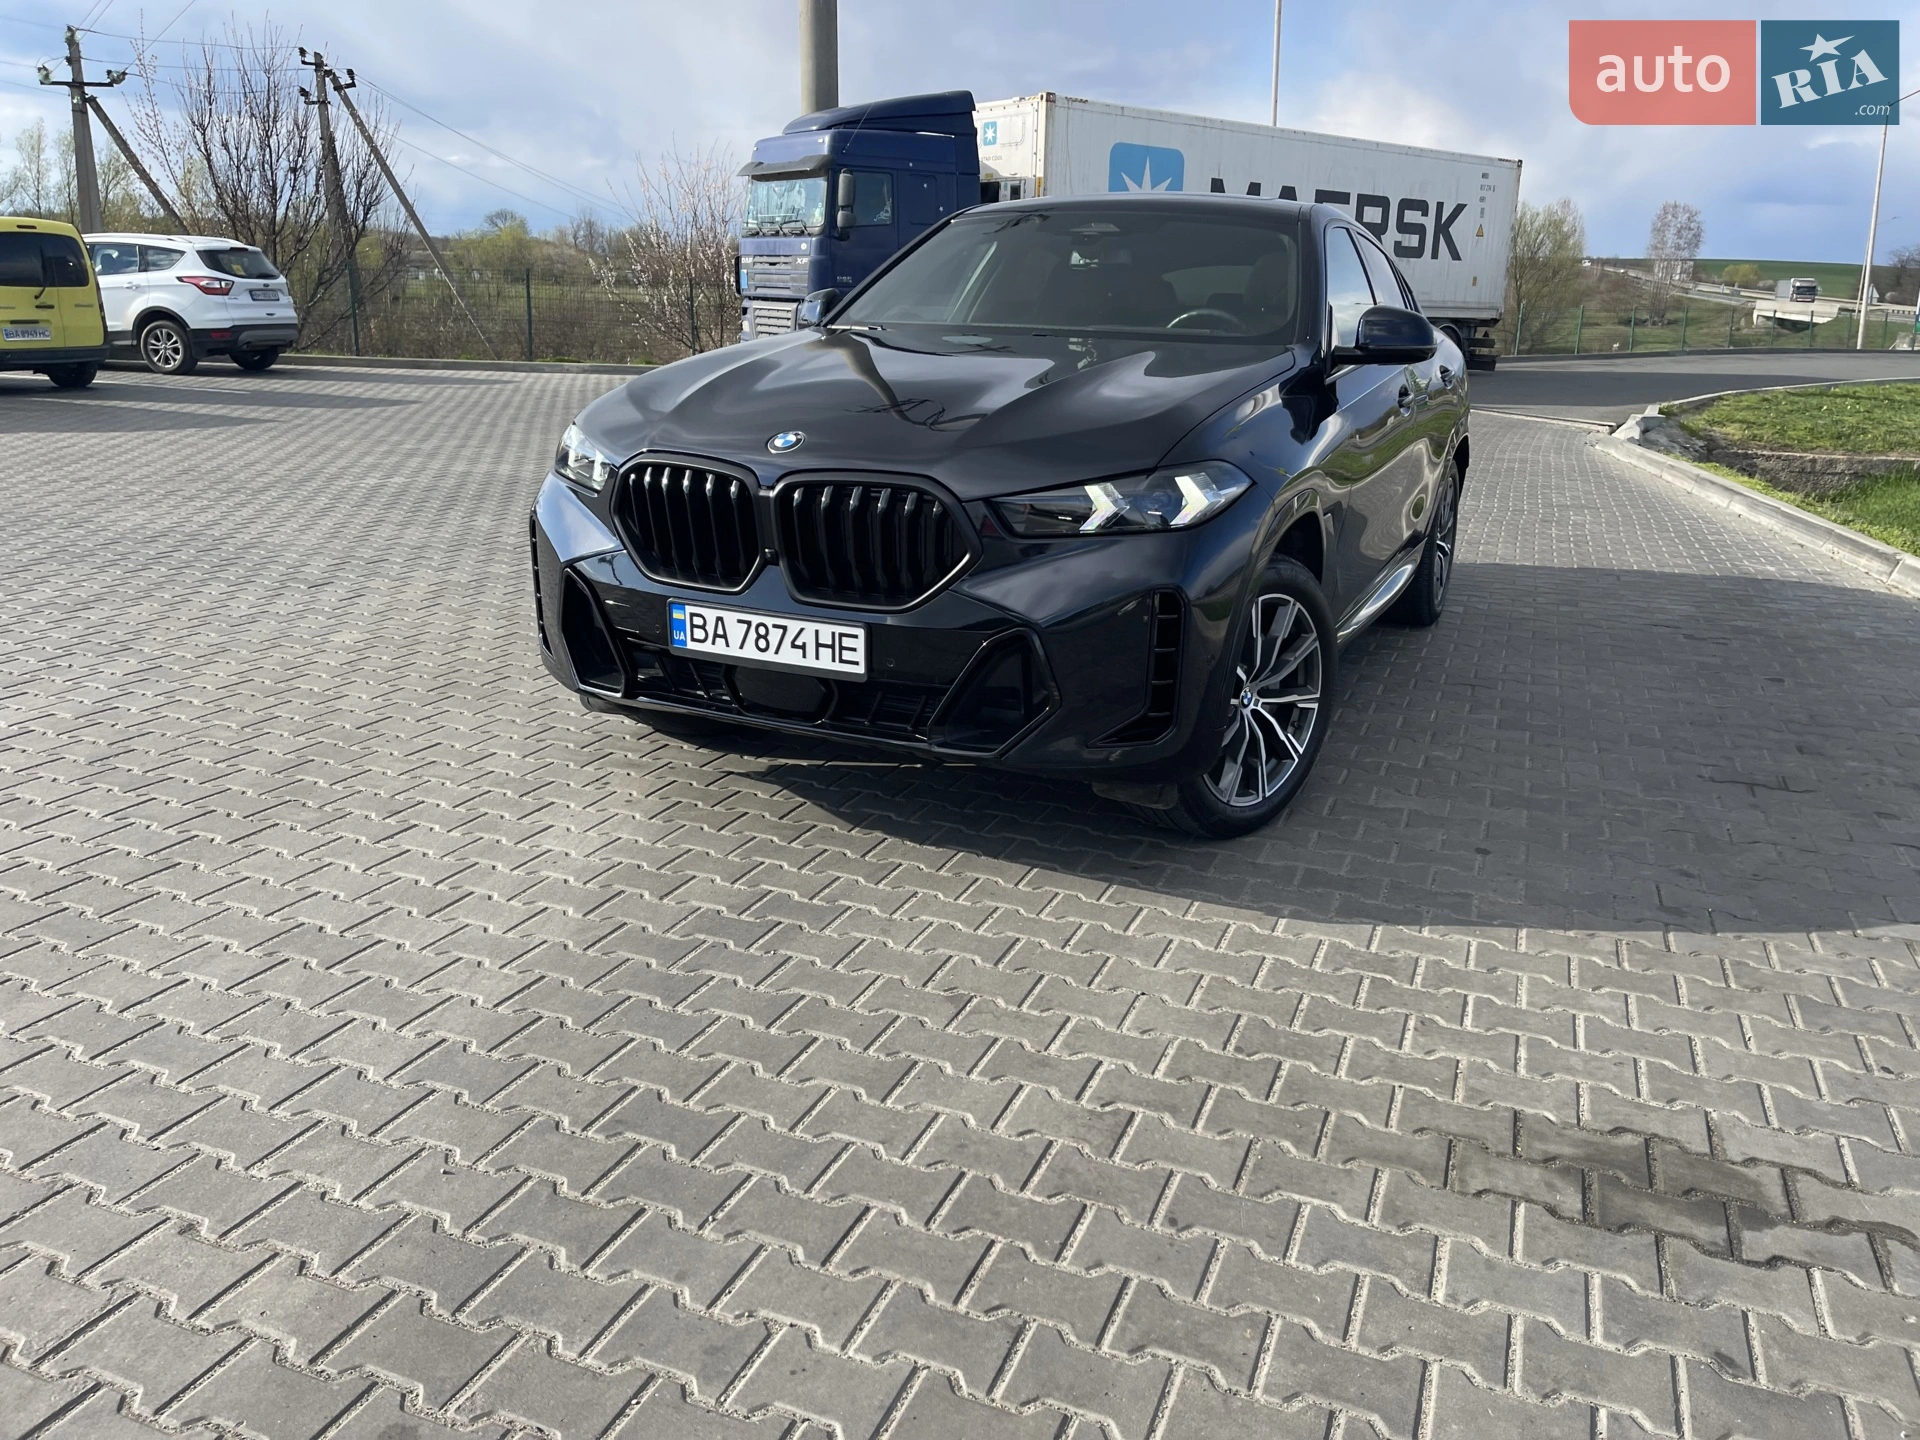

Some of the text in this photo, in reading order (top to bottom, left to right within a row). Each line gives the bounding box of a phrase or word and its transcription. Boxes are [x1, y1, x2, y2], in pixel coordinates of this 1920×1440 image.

[1210, 178, 1468, 261] RSK
[9, 330, 20, 339] BA
[39, 329, 50, 337] HC
[673, 630, 686, 641] UA
[689, 612, 860, 666] BA 7874 HE
